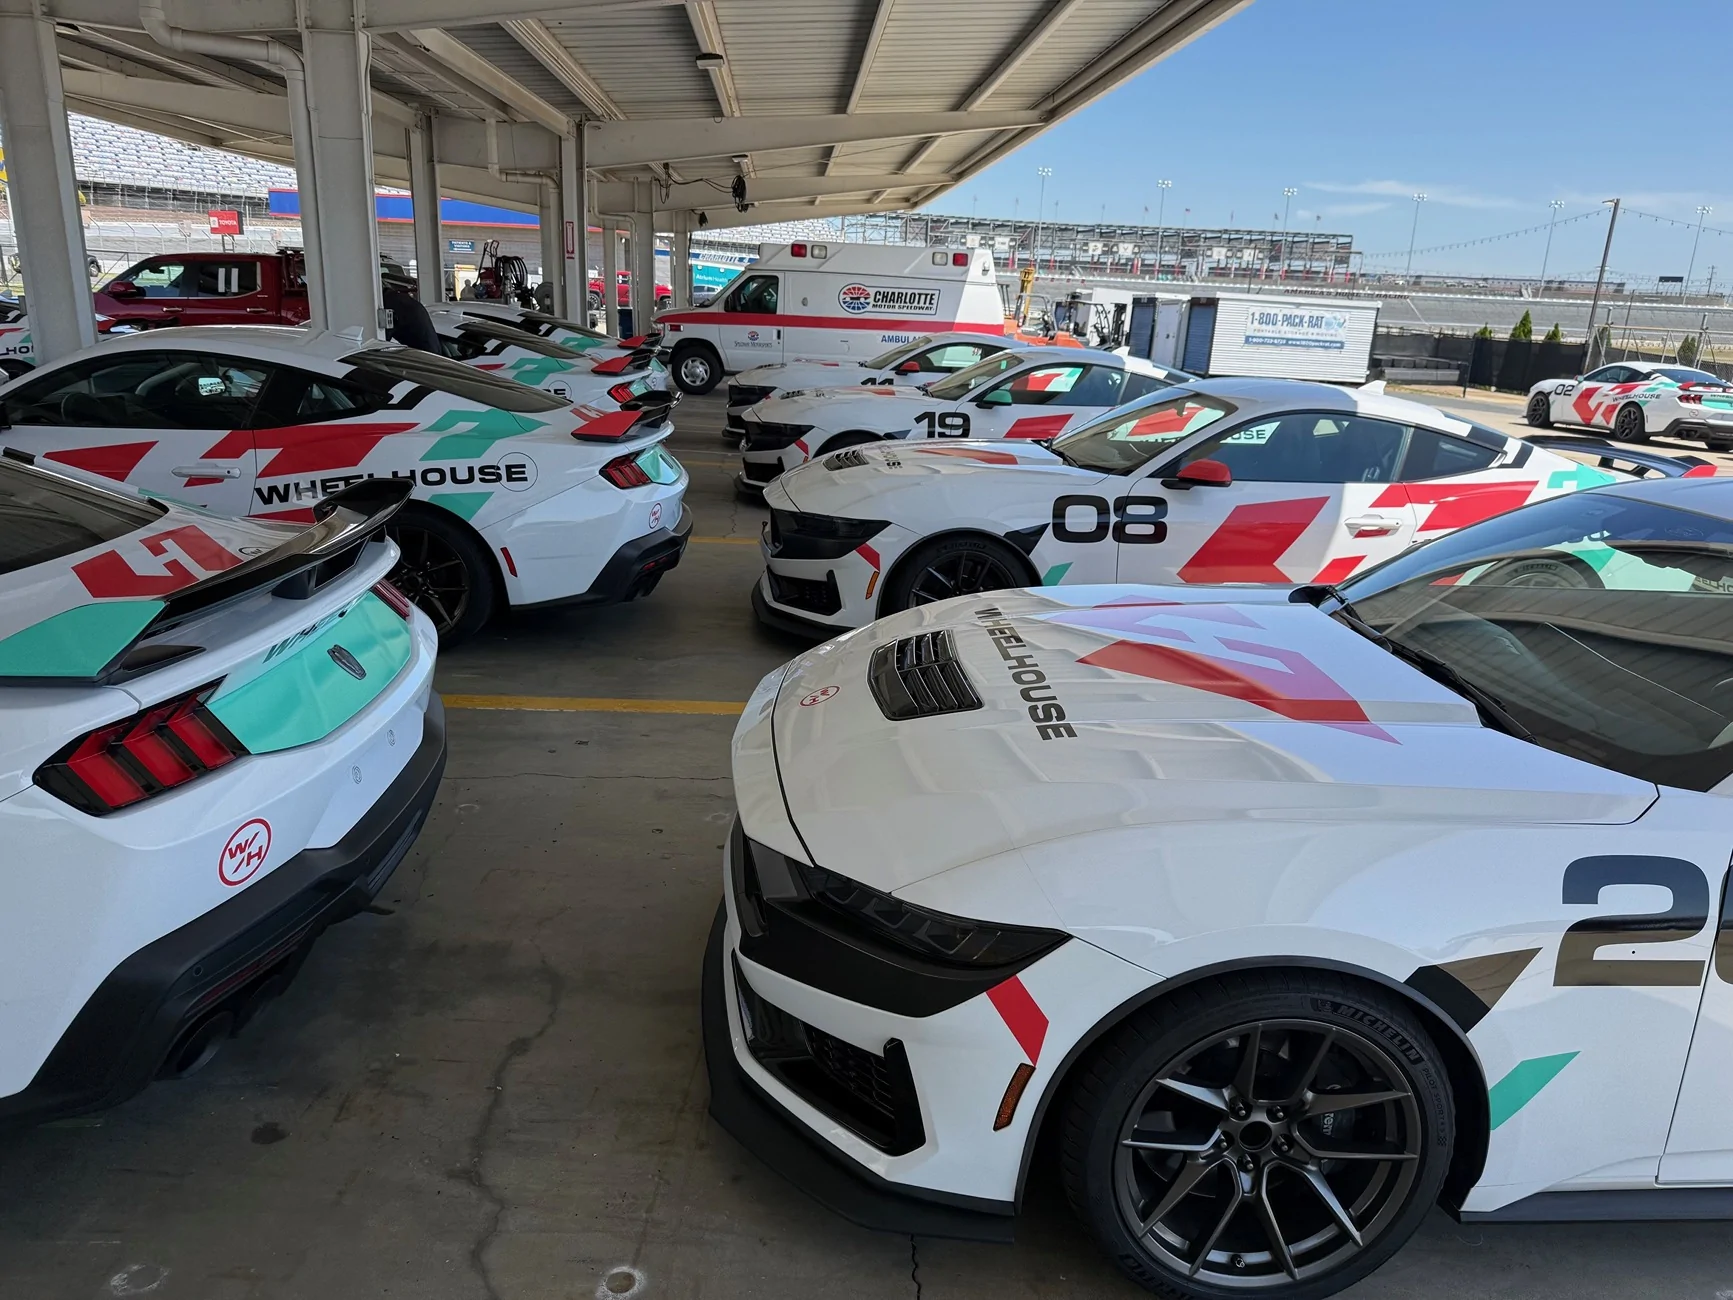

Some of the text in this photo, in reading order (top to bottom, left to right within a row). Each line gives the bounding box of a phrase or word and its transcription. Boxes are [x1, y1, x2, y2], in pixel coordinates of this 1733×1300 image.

[873, 290, 936, 306] CHARLOTTE
[1554, 383, 1576, 397] 02
[1612, 393, 1662, 402] WHEELHOUSE
[913, 411, 971, 438] 19
[1052, 494, 1168, 544] 08
[974, 607, 1078, 741] WHEELHOUSE
[1553, 855, 1733, 988] 2
[1334, 1004, 1420, 1062] MICHELIN
[1422, 1067, 1438, 1089] PILOT
[1433, 1093, 1445, 1120] SPORT
